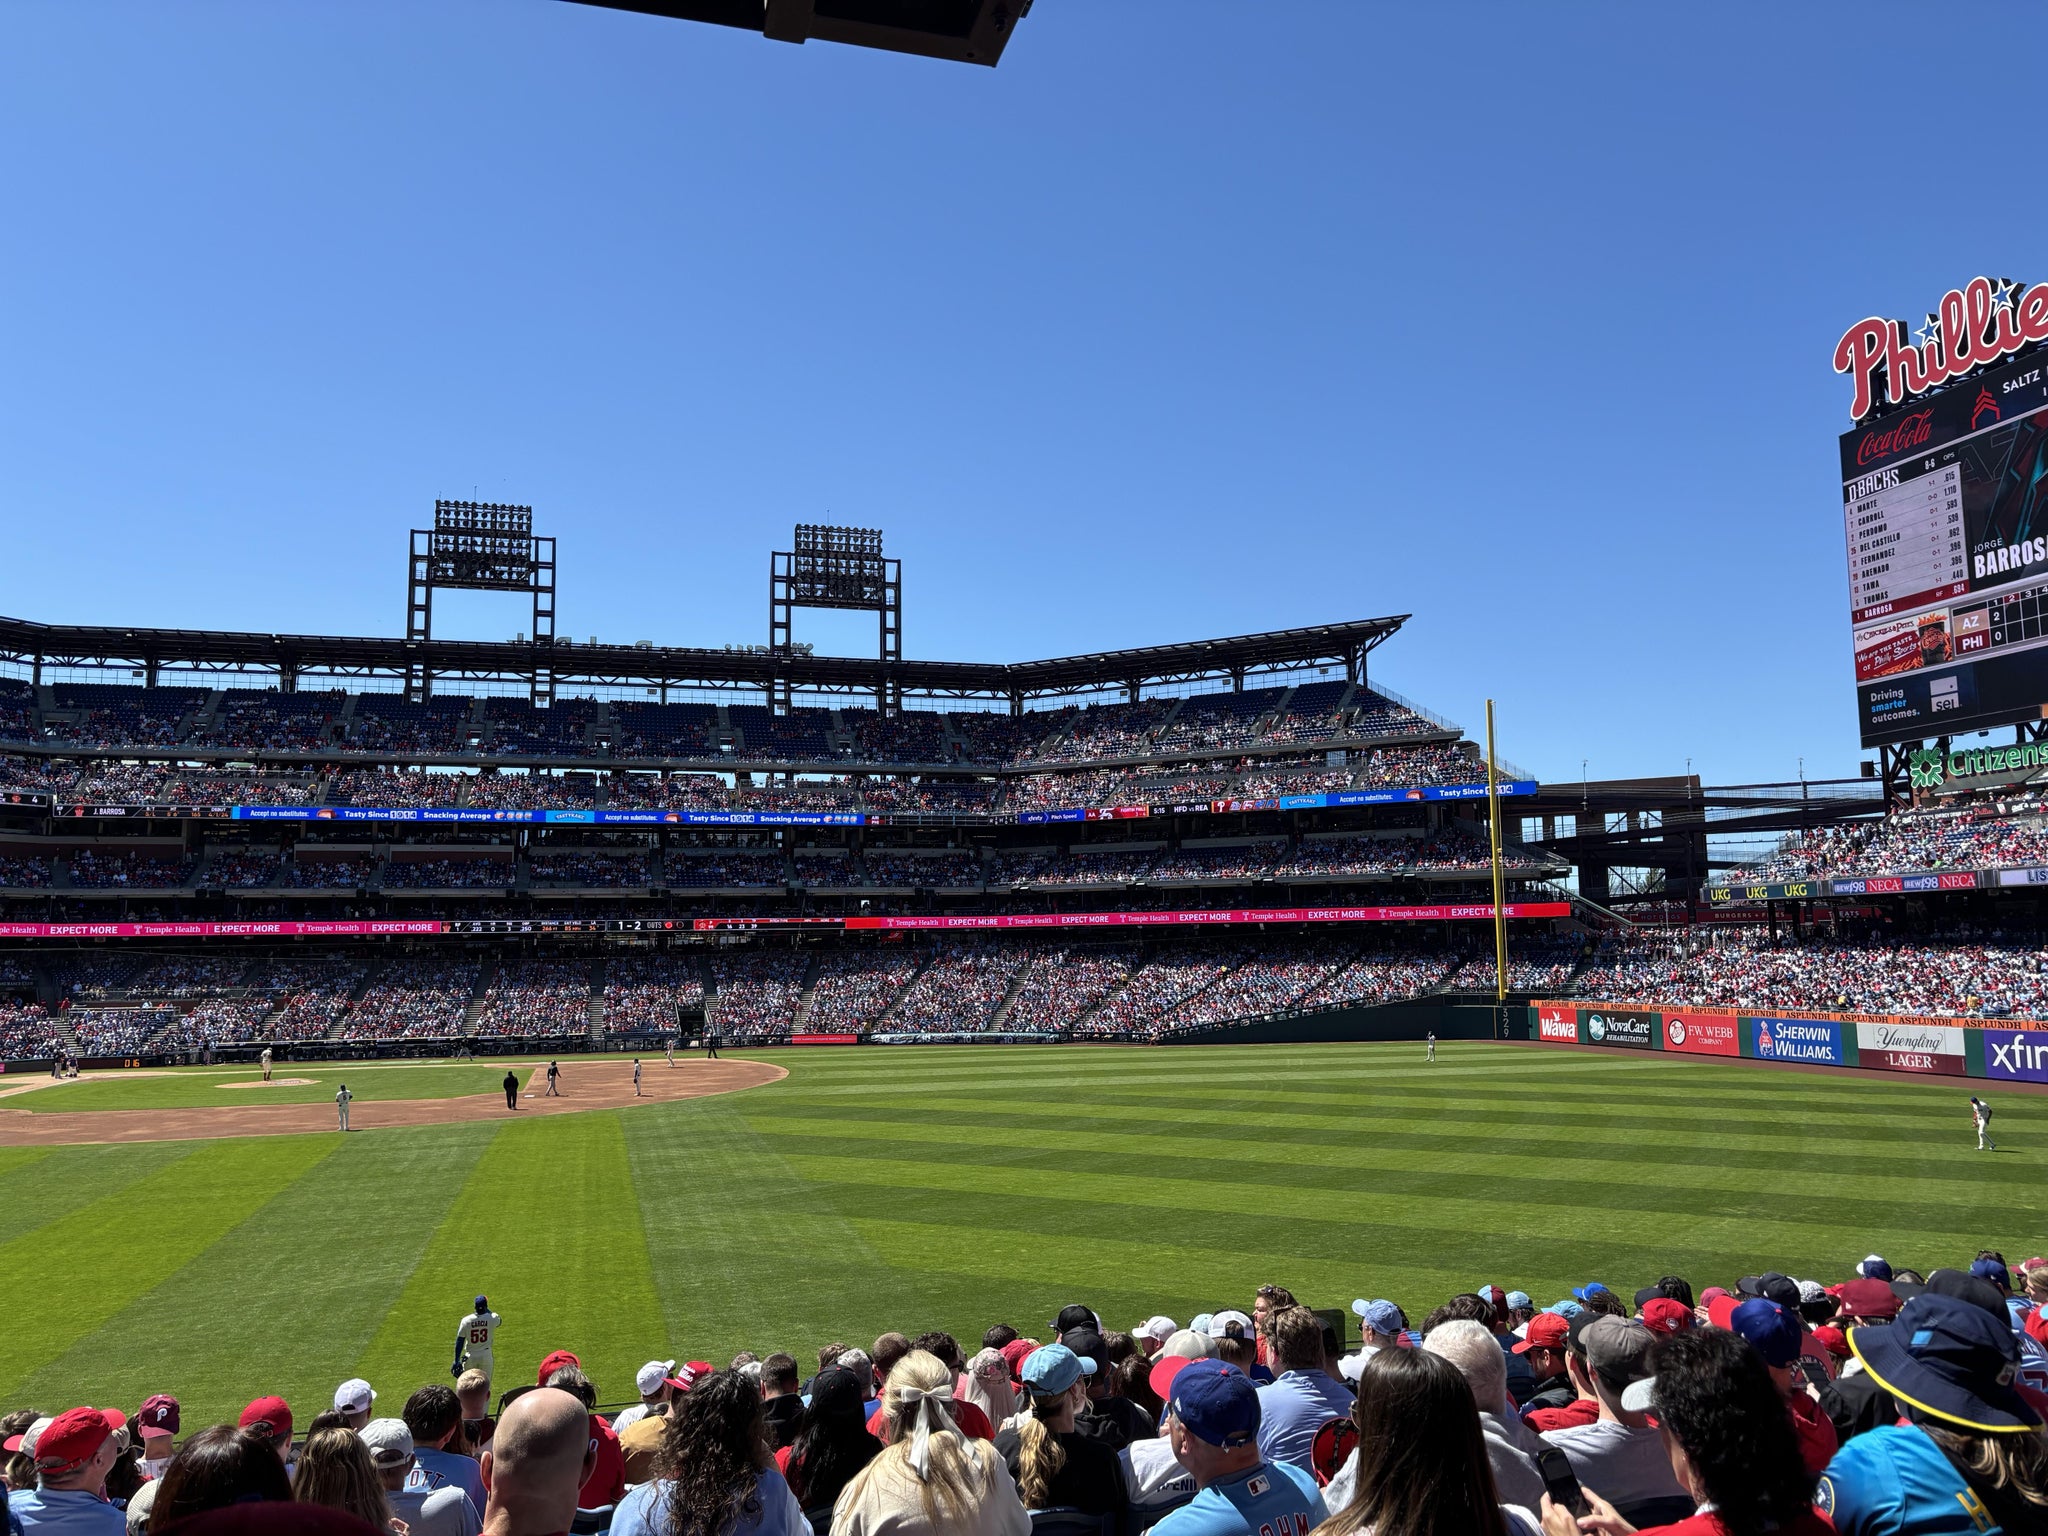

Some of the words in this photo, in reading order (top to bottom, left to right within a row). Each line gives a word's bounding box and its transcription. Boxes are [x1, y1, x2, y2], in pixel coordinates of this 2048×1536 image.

[2002, 369, 2041, 394] SALTZ
[1857, 407, 1935, 466] Coca-Cola
[1857, 499, 1877, 513] MARTE
[1858, 510, 1884, 526] CARROLL
[1859, 523, 1887, 539] PERDOMO
[1860, 542, 1870, 552] DEL
[1872, 532, 1900, 548] CASTILLO
[1973, 537, 2003, 553] JORGE
[1861, 548, 1895, 565] FERNANDEZ
[1974, 534, 2048, 579] BARROS
[1862, 563, 1890, 578] ARENADO
[1863, 580, 1880, 591] TAWA
[1864, 591, 1889, 605] THOMAS
[2008, 594, 2015, 602] 2
[2025, 590, 2032, 598] 3
[1865, 603, 1893, 618] BARROSA
[1962, 615, 1979, 630] AZ
[1993, 611, 2000, 621] 2
[1879, 643, 1892, 654] THE
[1892, 635, 1913, 648] TASTE
[1962, 635, 1983, 650] PHI
[1994, 631, 2002, 641] 0
[1893, 641, 1917, 656] Sports
[1870, 688, 1904, 703] Driving
[1871, 698, 1907, 713] smarter
[1872, 707, 1920, 724] outcomes.
[1440, 789, 1461, 798] Tasty
[1462, 788, 1484, 796] Since
[1485, 785, 1513, 795] 114
[1340, 796, 1357, 804] Accept
[250, 810, 269, 820] Accept
[344, 811, 366, 819] Tasty
[423, 811, 458, 820] Snacking
[460, 812, 491, 820] Average
[605, 814, 622, 822] Accept
[689, 815, 708, 823] Tasty
[760, 815, 791, 824] Snacking
[793, 815, 821, 824] Average
[1868, 878, 1901, 892] NECA
[1940, 874, 1976, 888] NECA
[1711, 888, 1731, 901] UKG
[1746, 886, 1767, 899] UKG
[1784, 883, 1807, 897] UKG
[1251, 912, 1274, 920] Temple
[1275, 911, 1297, 919] Health
[1308, 911, 1338, 919] EXPECT
[1341, 910, 1365, 918] MORE
[1389, 909, 1413, 918] Temple
[1416, 909, 1439, 917] Health
[1452, 908, 1486, 916] EXPECT
[1488, 907, 1515, 915] MRE
[1714, 911, 1752, 919] BURGERS
[618, 921, 623, 929] 1
[634, 921, 641, 930] 2
[647, 921, 662, 929] OUTS
[896, 919, 917, 927] Temple
[918, 918, 939, 926] Health
[949, 918, 982, 926] EXPECT
[1062, 916, 1087, 924] EXPECT
[1089, 915, 1109, 923] MORE
[12, 926, 37, 934] Health
[50, 926, 88, 935] EXPECT
[89, 926, 118, 934] MORE
[145, 926, 173, 935] Temple
[175, 925, 201, 933] Health
[214, 925, 251, 933] EXPECT
[253, 924, 281, 932] MORE
[306, 924, 333, 932] Temple
[371, 924, 406, 932] EXPECT
[407, 923, 433, 931] MORE
[1574, 1002, 1605, 1010] ASPLUNDH
[1610, 1003, 1642, 1011] ASPLUNDH
[1649, 1005, 1684, 1013] ASPLUNDH
[1690, 1007, 1729, 1016] ASPLUNDH
[1736, 1008, 1777, 1018] ASPLUNDH
[1785, 1011, 1831, 1021] ASPLUNDH
[1839, 1013, 1889, 1024] ASPLUNDH
[1605, 1017, 1650, 1034] NovaCare
[1900, 1016, 1952, 1027] ASPLUNDH
[1963, 1019, 2022, 1030] ASPLUNDH
[1541, 1018, 1576, 1038] Wawa
[1688, 1025, 1703, 1037] F.W.
[1704, 1026, 1734, 1039] WEBB
[1775, 1022, 1831, 1042] SHERWIN
[1606, 1034, 1649, 1044] REHABILITATION
[1698, 1038, 1723, 1046] COMPANY
[1876, 1026, 1944, 1053] Yuengling
[1889, 1053, 1933, 1069] LAGER
[470, 1328, 488, 1344] 53
[410, 1469, 446, 1491] OTT
[1259, 1511, 1310, 1536] OHM
